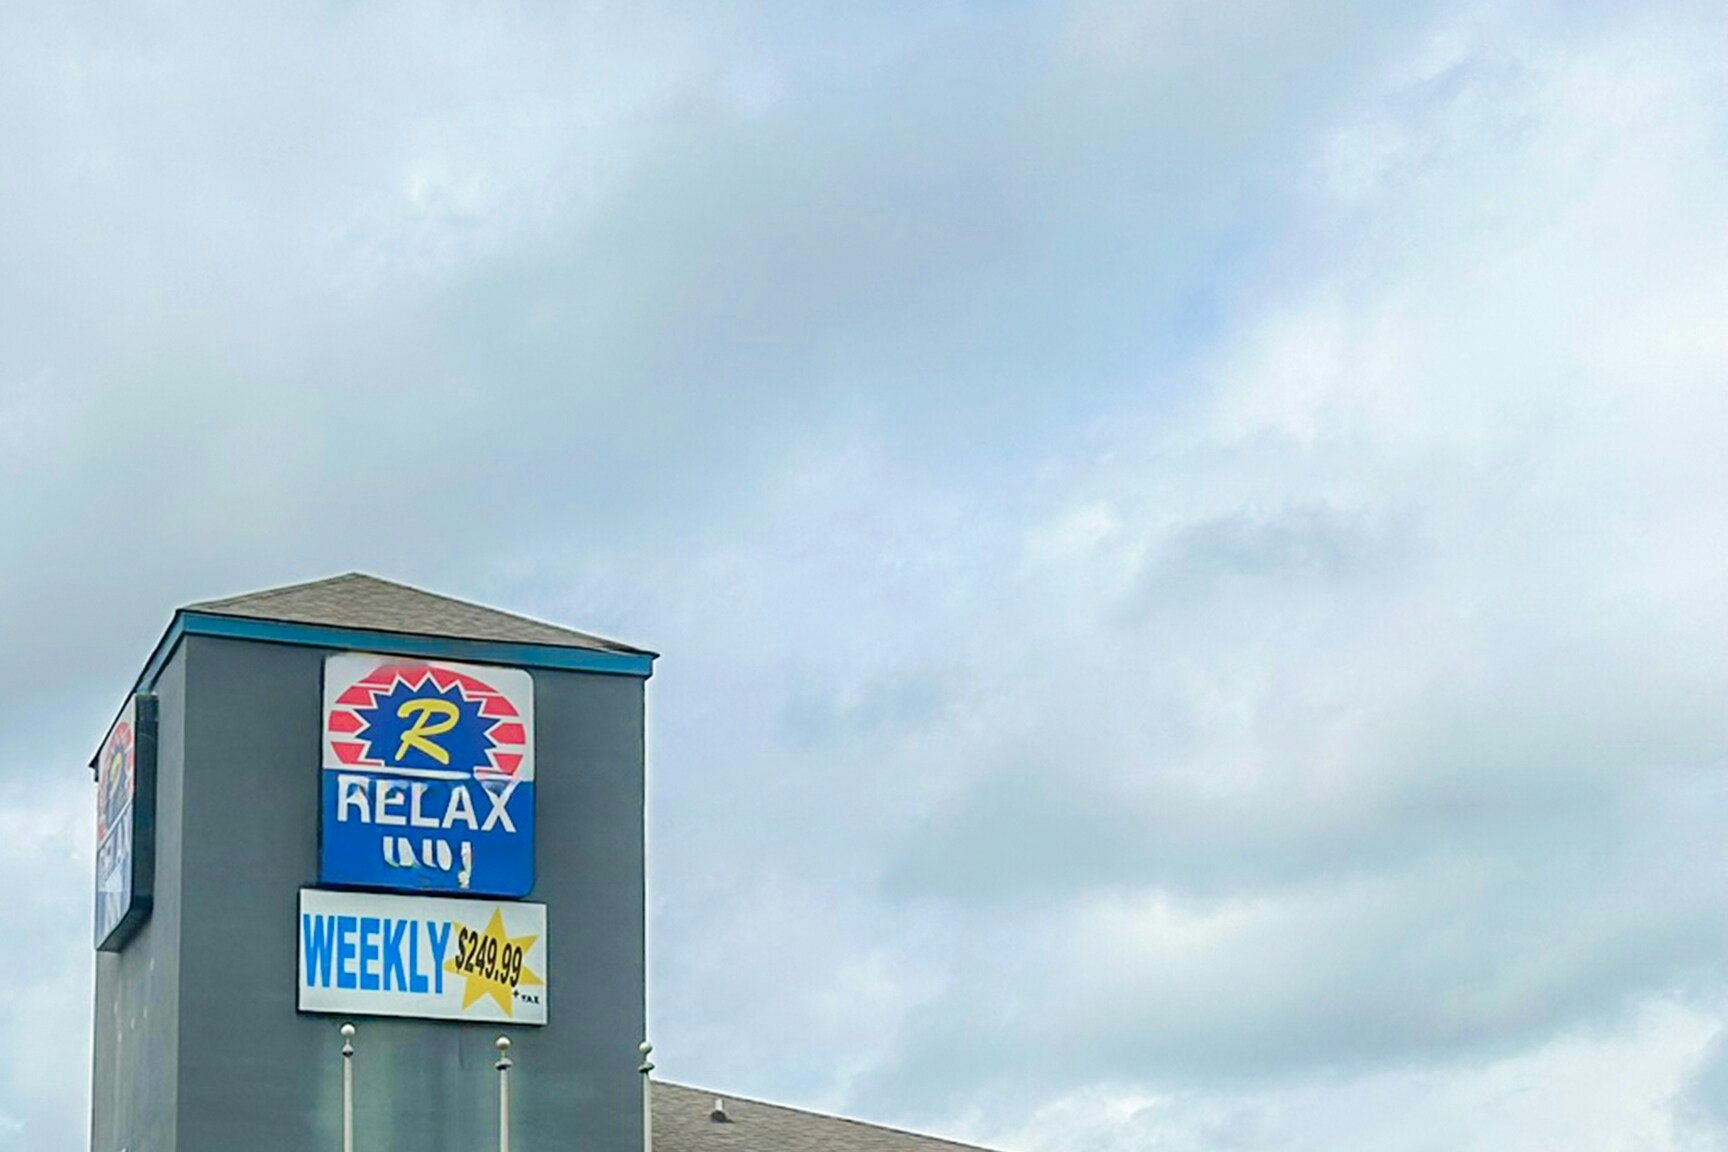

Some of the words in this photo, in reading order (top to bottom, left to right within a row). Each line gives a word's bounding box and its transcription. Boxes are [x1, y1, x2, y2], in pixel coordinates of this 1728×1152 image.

[395, 698, 460, 765] R
[337, 773, 520, 833] RELAX
[303, 912, 451, 995] WEEKLY
[455, 926, 522, 988] $249.99
